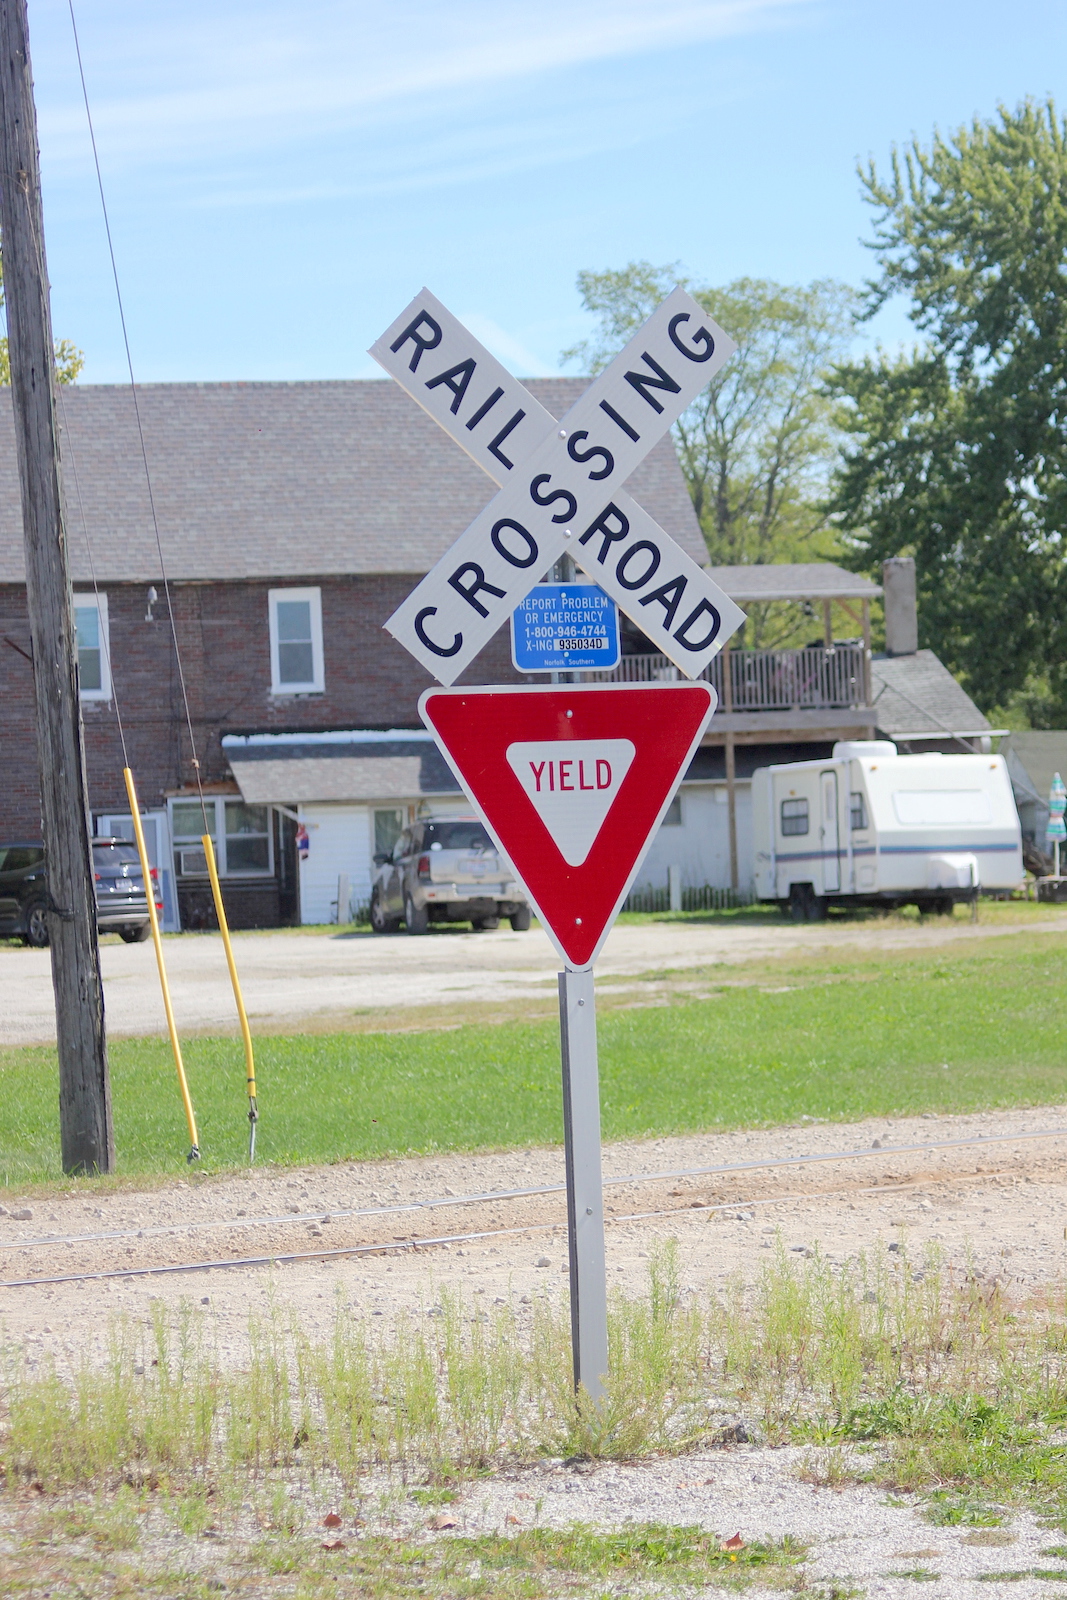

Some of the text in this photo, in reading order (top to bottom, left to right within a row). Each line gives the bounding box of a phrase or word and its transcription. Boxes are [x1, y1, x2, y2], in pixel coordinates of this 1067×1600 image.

[389, 309, 721, 653] RAIL ROAD
[414, 312, 715, 658] CROSSING
[519, 597, 608, 610] REPORT PROBLEM
[525, 611, 603, 624] OR EMERGENCY
[525, 625, 606, 638] 1-800-946-4744
[526, 638, 603, 651] X-ING 935034D
[529, 759, 612, 791] YIELD
